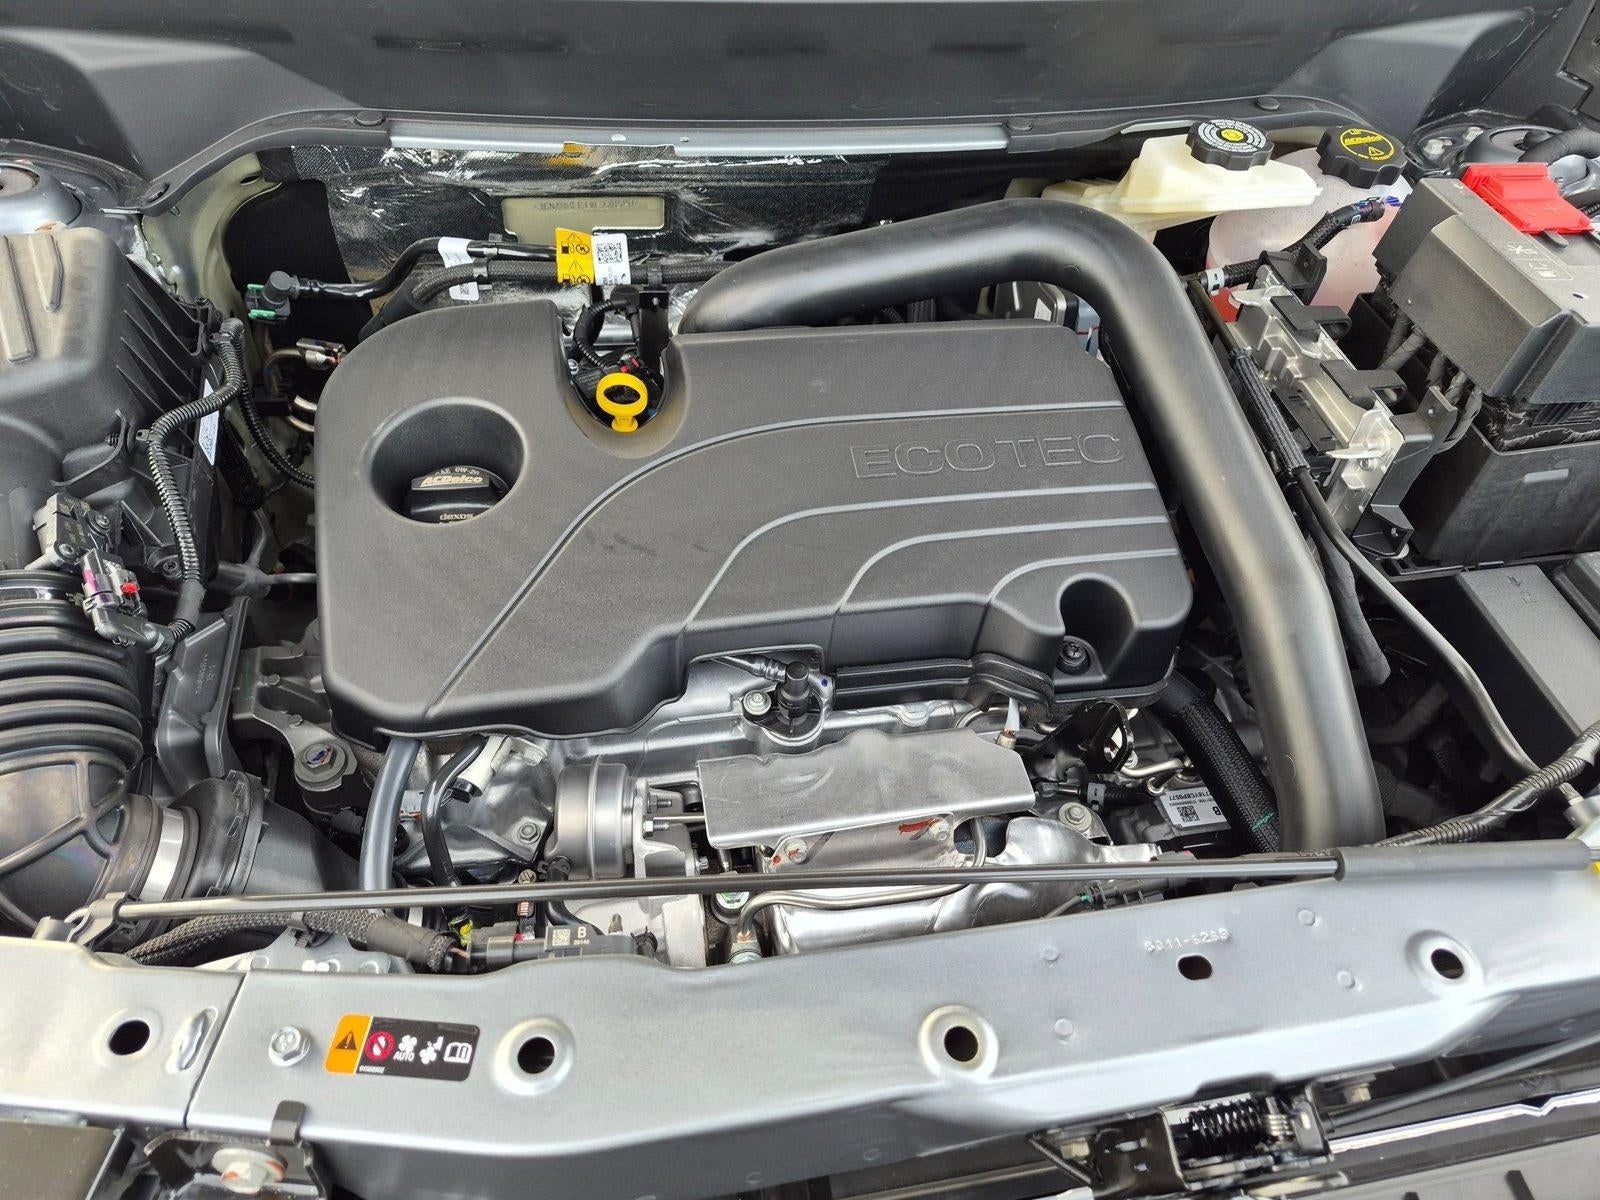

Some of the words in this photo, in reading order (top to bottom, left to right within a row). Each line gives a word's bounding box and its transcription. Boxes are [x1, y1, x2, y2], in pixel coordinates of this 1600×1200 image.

[850, 434, 1125, 478] ECOTEC
[420, 475, 484, 487] ACDelco
[1212, 806, 1222, 815] B
[577, 926, 587, 939] B
[393, 1051, 415, 1063] AUTO
